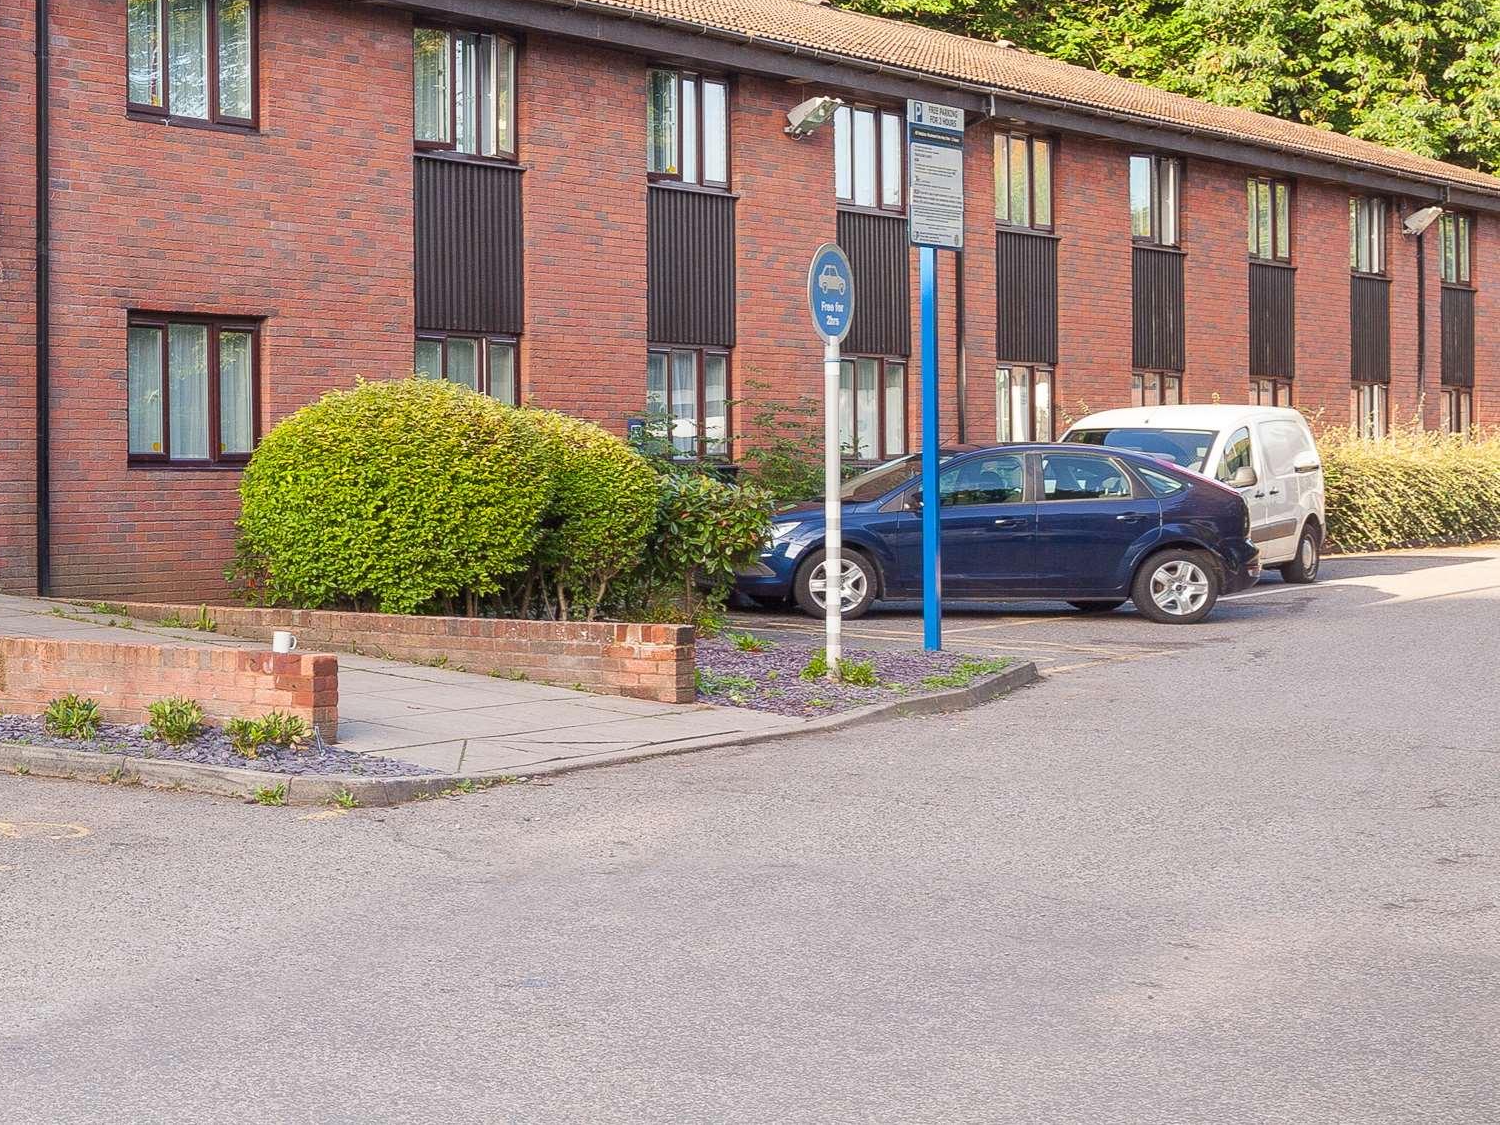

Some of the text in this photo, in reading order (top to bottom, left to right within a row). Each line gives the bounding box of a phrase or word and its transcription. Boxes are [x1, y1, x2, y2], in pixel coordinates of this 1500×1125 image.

[928, 105, 958, 118] FREE PARKING
[930, 115, 938, 124] FOR
[943, 118, 957, 128] HOURS
[821, 301, 844, 313] Free for
